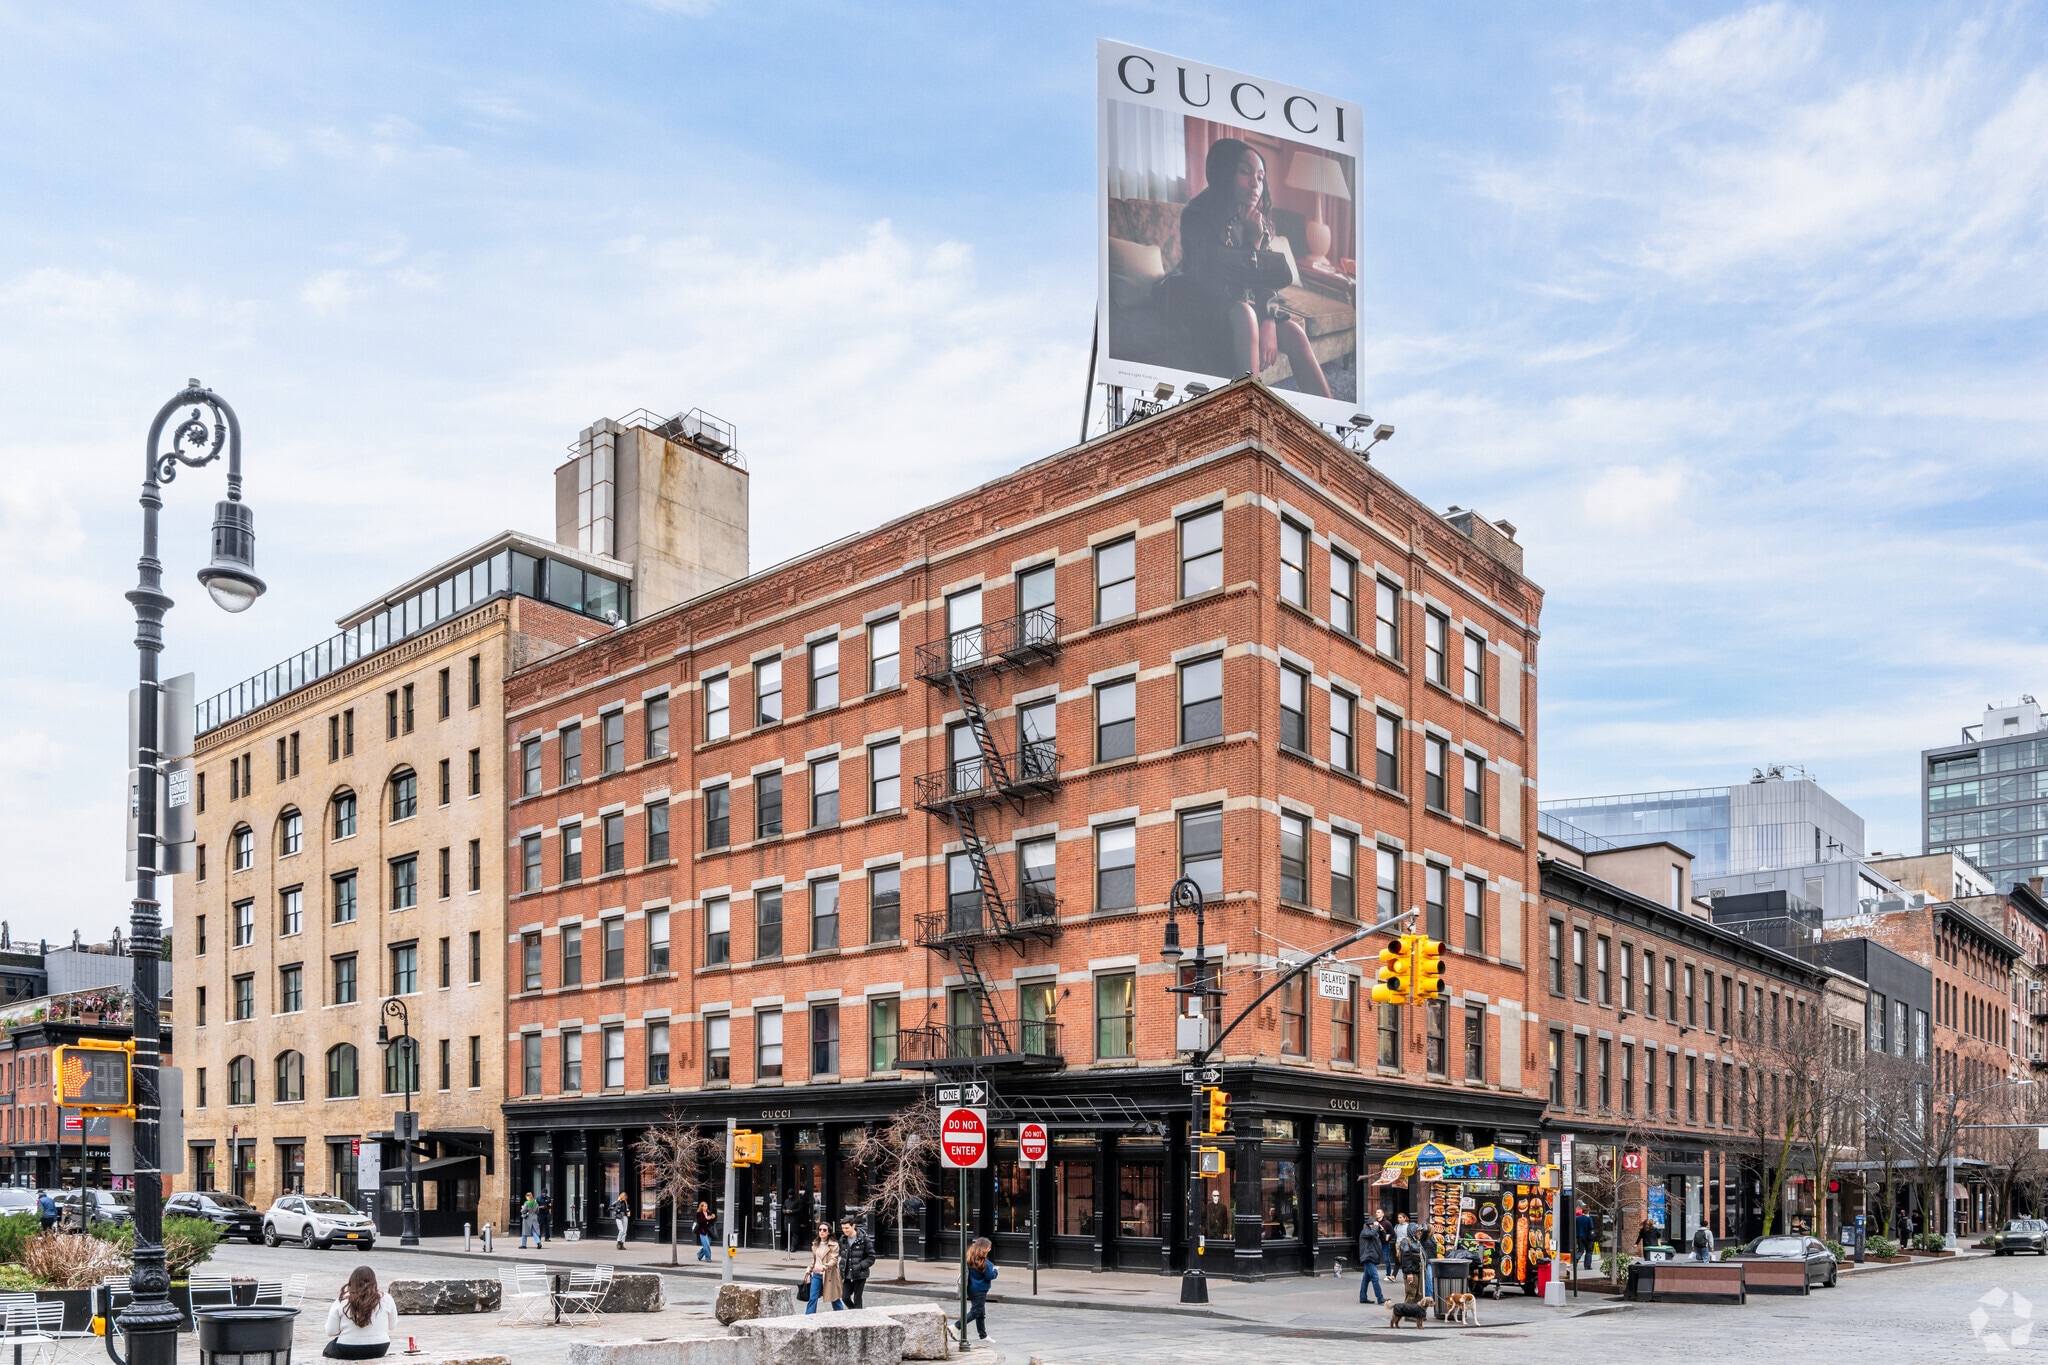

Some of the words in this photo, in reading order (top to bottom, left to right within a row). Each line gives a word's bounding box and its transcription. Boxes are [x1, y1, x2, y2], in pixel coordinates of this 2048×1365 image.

[1117, 55, 1345, 143] GUCCI
[1321, 972, 1347, 985] DELAYED
[1325, 984, 1344, 996] GREEN
[943, 1090, 958, 1100] ONE
[965, 1089, 980, 1099] WAY
[1330, 1098, 1360, 1110] GUCCI
[761, 1109, 791, 1118] GUCCI
[949, 1120, 960, 1130] DO
[962, 1120, 978, 1130] NOT
[951, 1145, 977, 1156] ENTER
